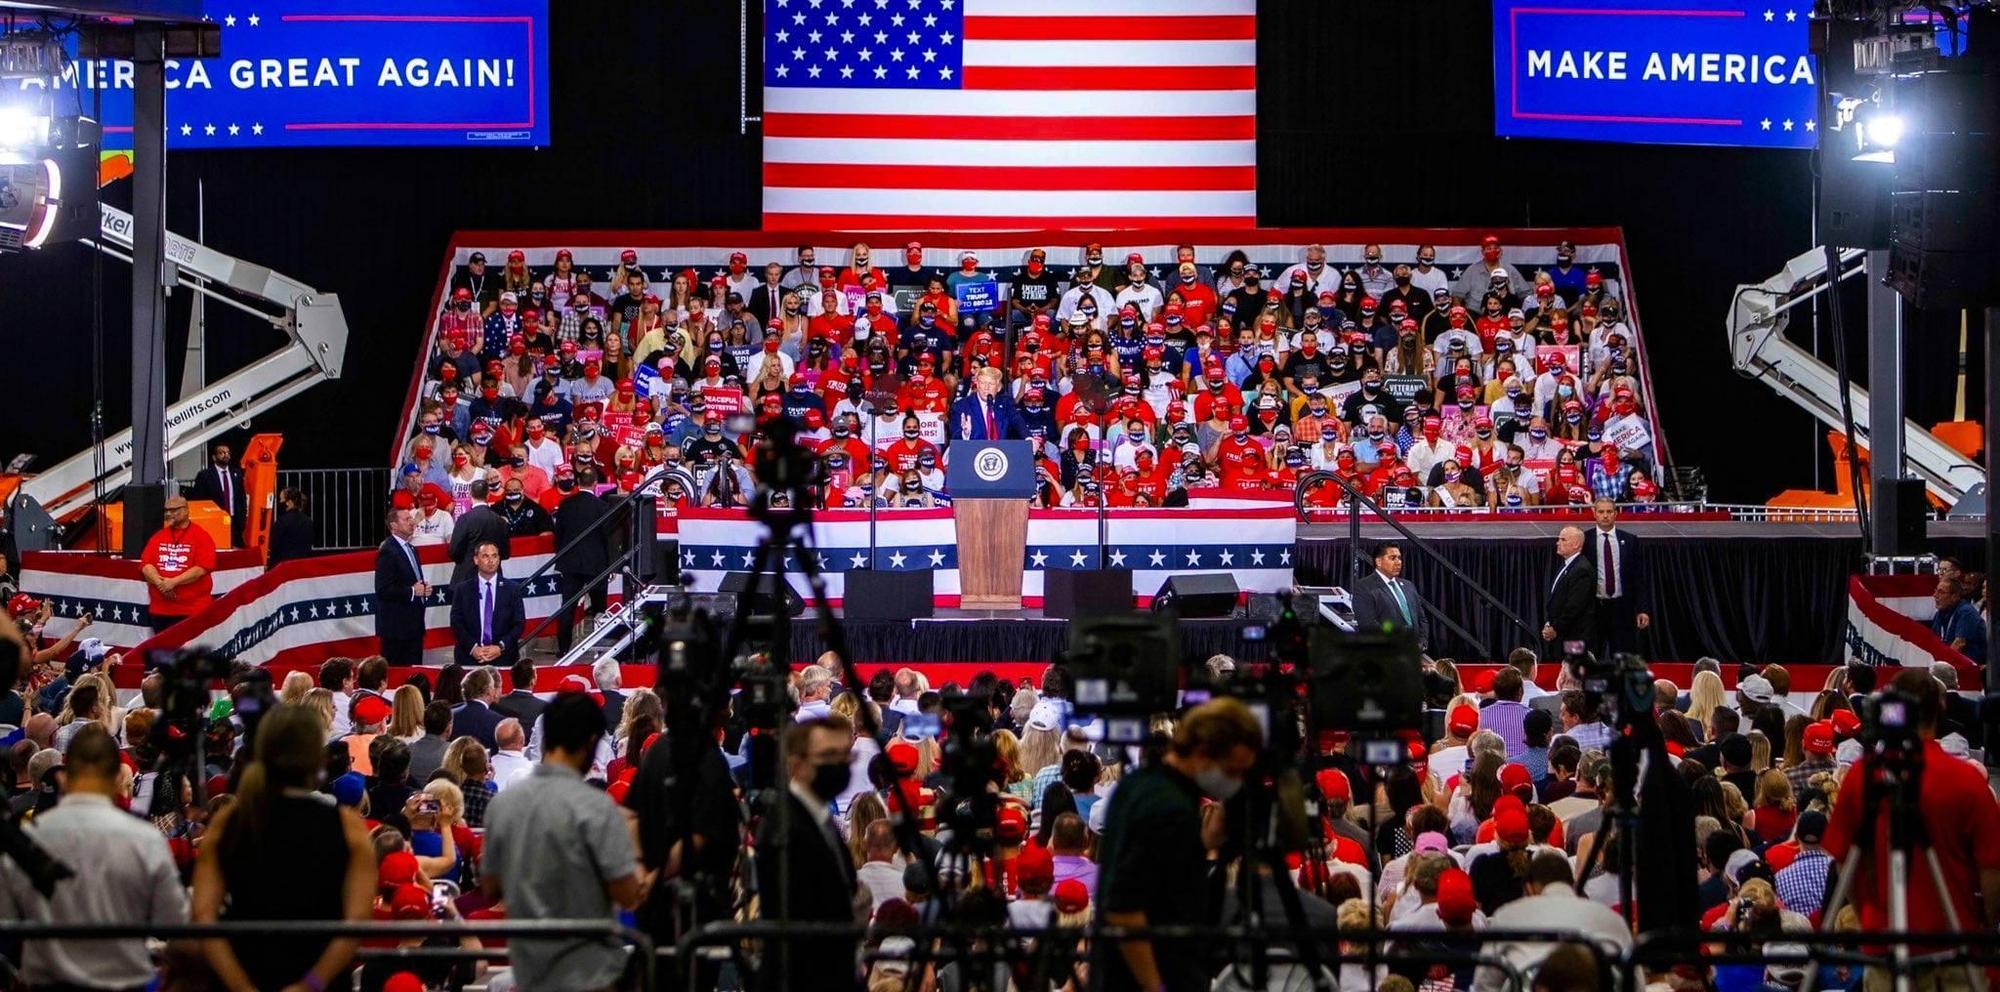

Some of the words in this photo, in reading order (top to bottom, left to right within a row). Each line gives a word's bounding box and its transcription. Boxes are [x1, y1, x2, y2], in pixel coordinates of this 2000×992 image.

[20, 60, 212, 90] MERCA
[230, 58, 361, 88] GREAT
[377, 58, 516, 88] AGAIN!
[1527, 50, 1628, 80] MAKE
[1642, 52, 1815, 85] AMERICA
[1021, 284, 1048, 292] AMERICA
